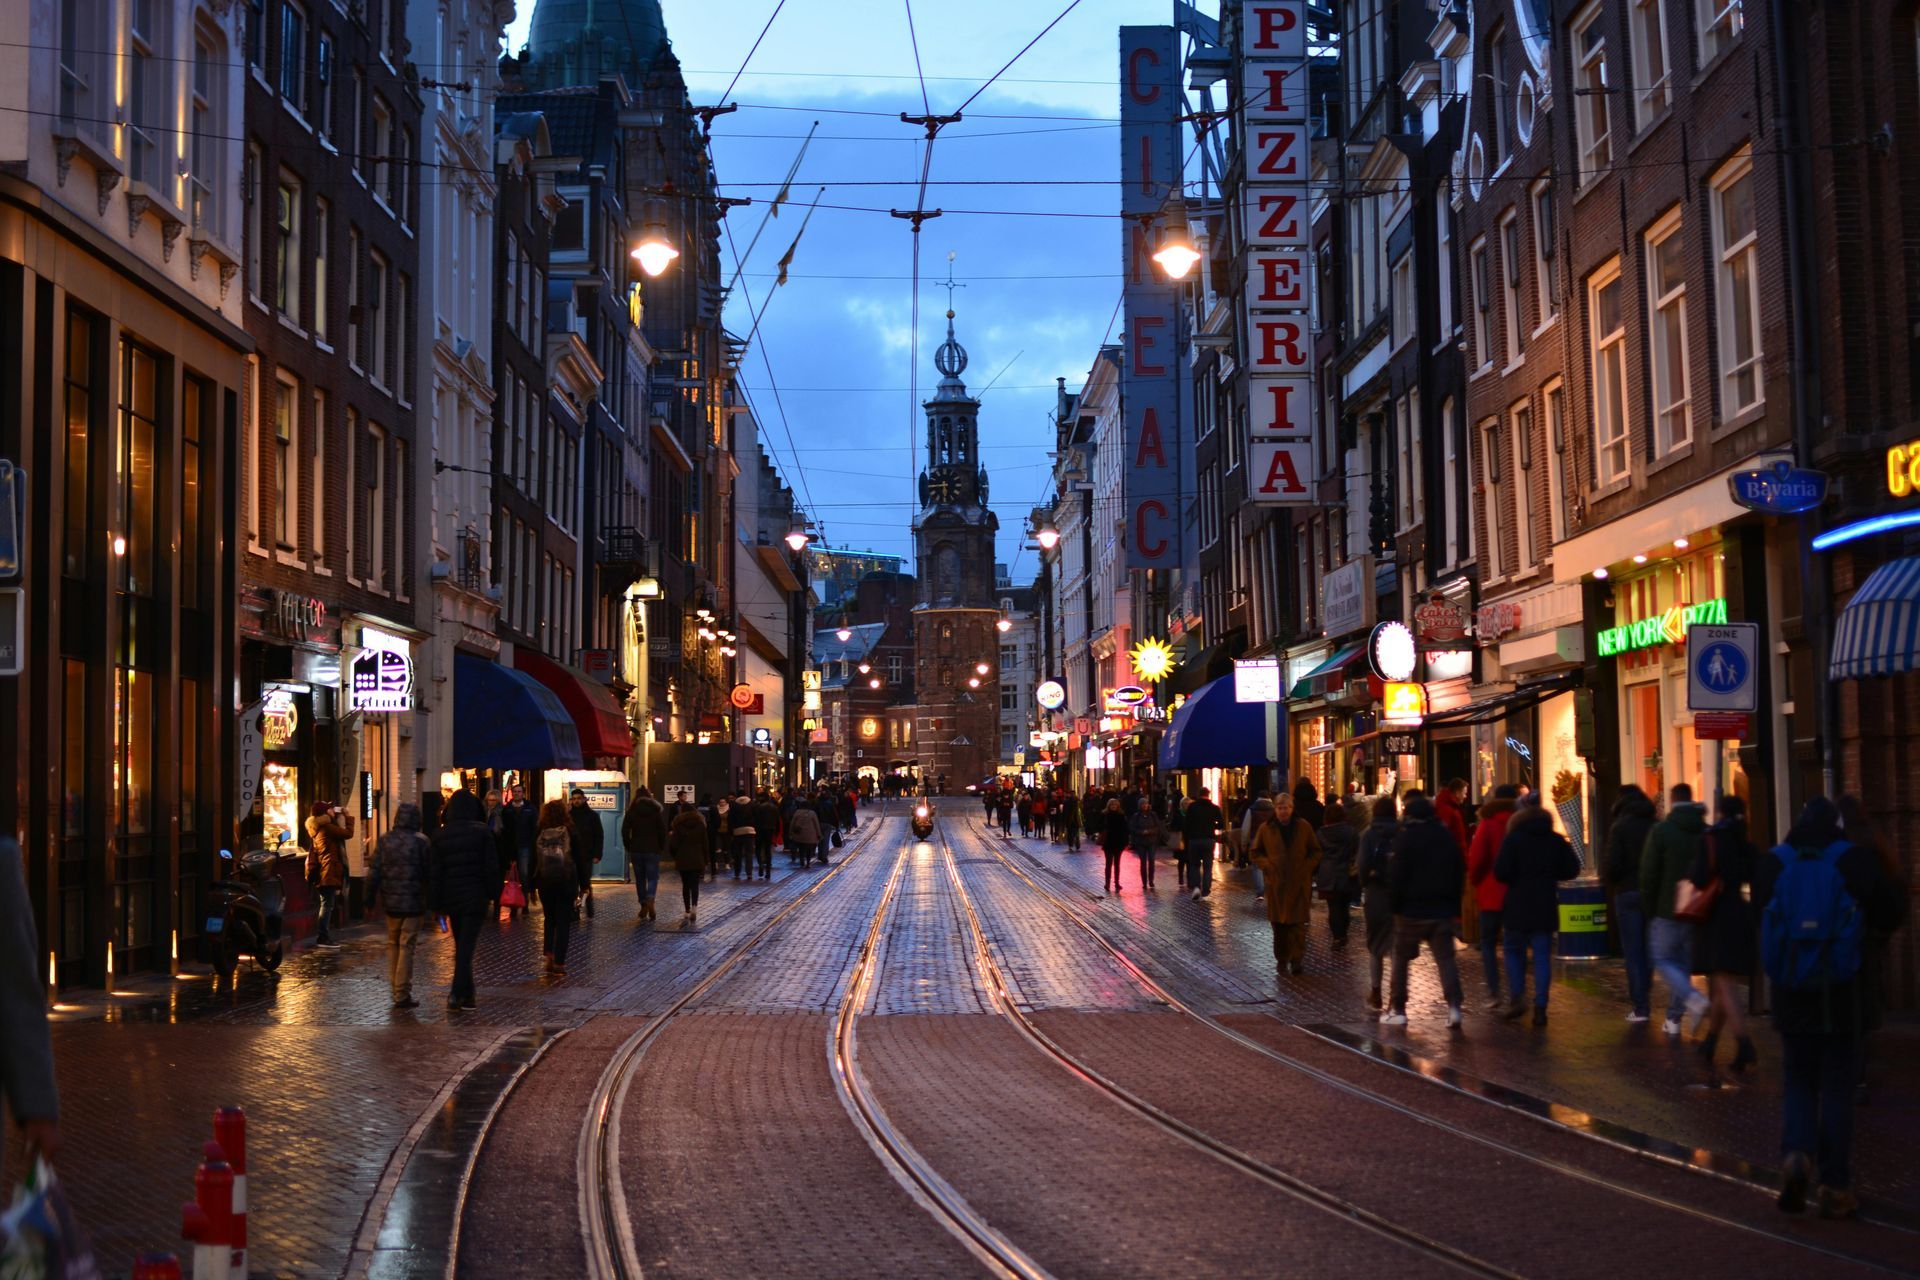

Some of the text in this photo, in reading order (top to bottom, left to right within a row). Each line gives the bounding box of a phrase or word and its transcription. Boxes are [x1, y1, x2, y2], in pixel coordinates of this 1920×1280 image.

[1253, 7, 1307, 493] PIZZERIA
[1128, 47, 1168, 559] CINEAC
[1746, 481, 1817, 499] Bavaria
[1421, 606, 1456, 617] Cakes
[1598, 598, 1727, 656] NEW YORK PIZZA
[1707, 629, 1739, 639] ZONE
[242, 719, 254, 801] TATTOO
[341, 725, 350, 796] TATTOO
